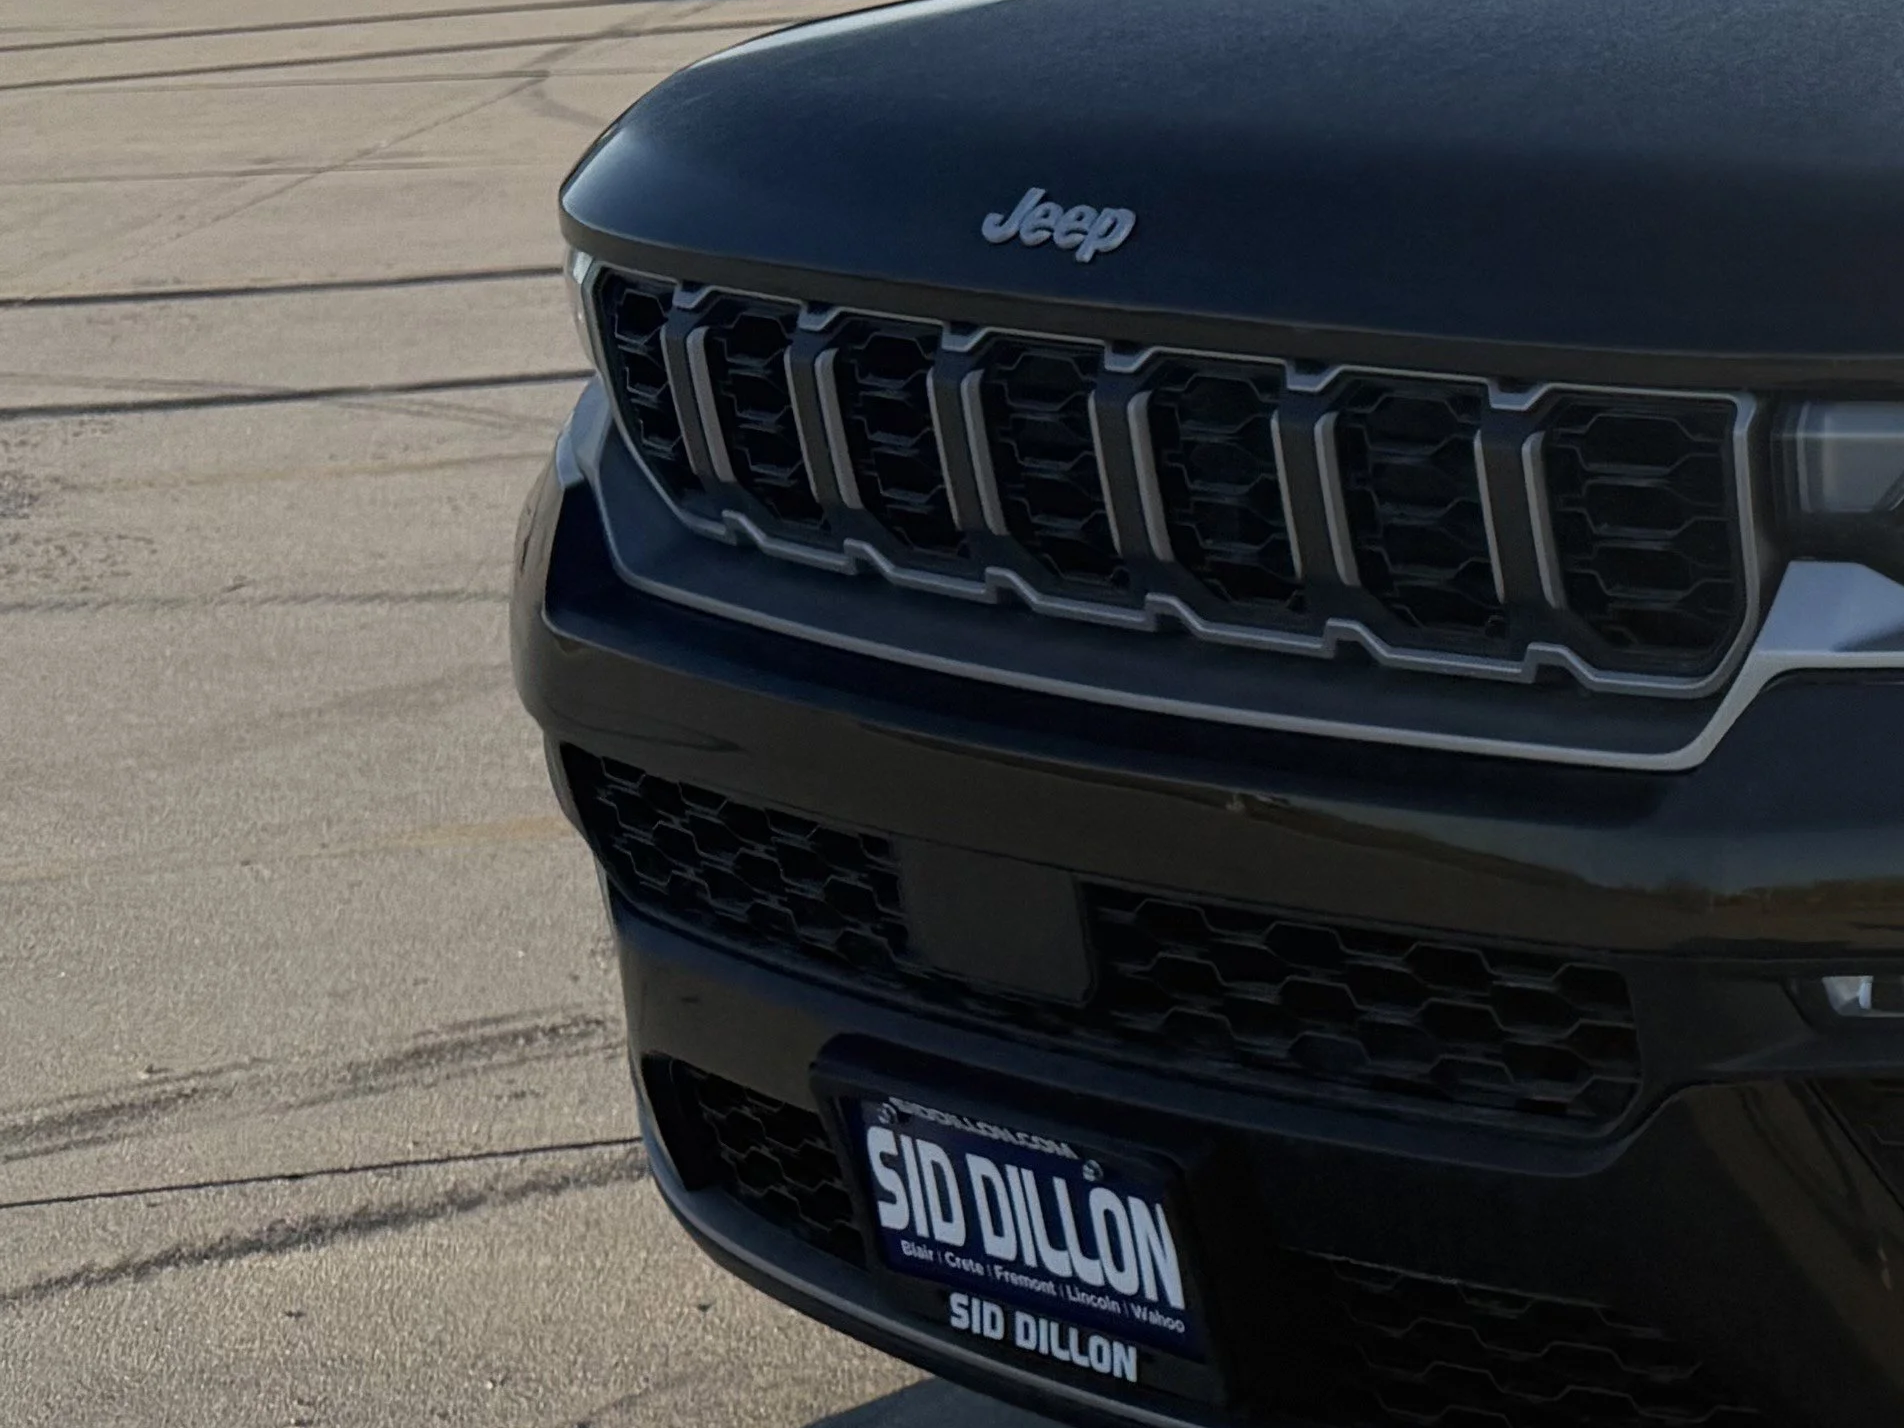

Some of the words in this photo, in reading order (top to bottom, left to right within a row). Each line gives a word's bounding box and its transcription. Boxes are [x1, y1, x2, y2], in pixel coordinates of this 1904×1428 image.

[982, 187, 1136, 262] Jeep
[867, 1126, 965, 1246] SID
[966, 1152, 1185, 1310] DILLON
[901, 1240, 934, 1262] Blair
[945, 1254, 984, 1276] Crete
[995, 1265, 1057, 1297] Fremont
[1067, 1284, 1120, 1313] Lincoln
[1132, 1304, 1185, 1333] Wahoo
[950, 1292, 1004, 1340] SID
[1015, 1311, 1137, 1382] DILLON
